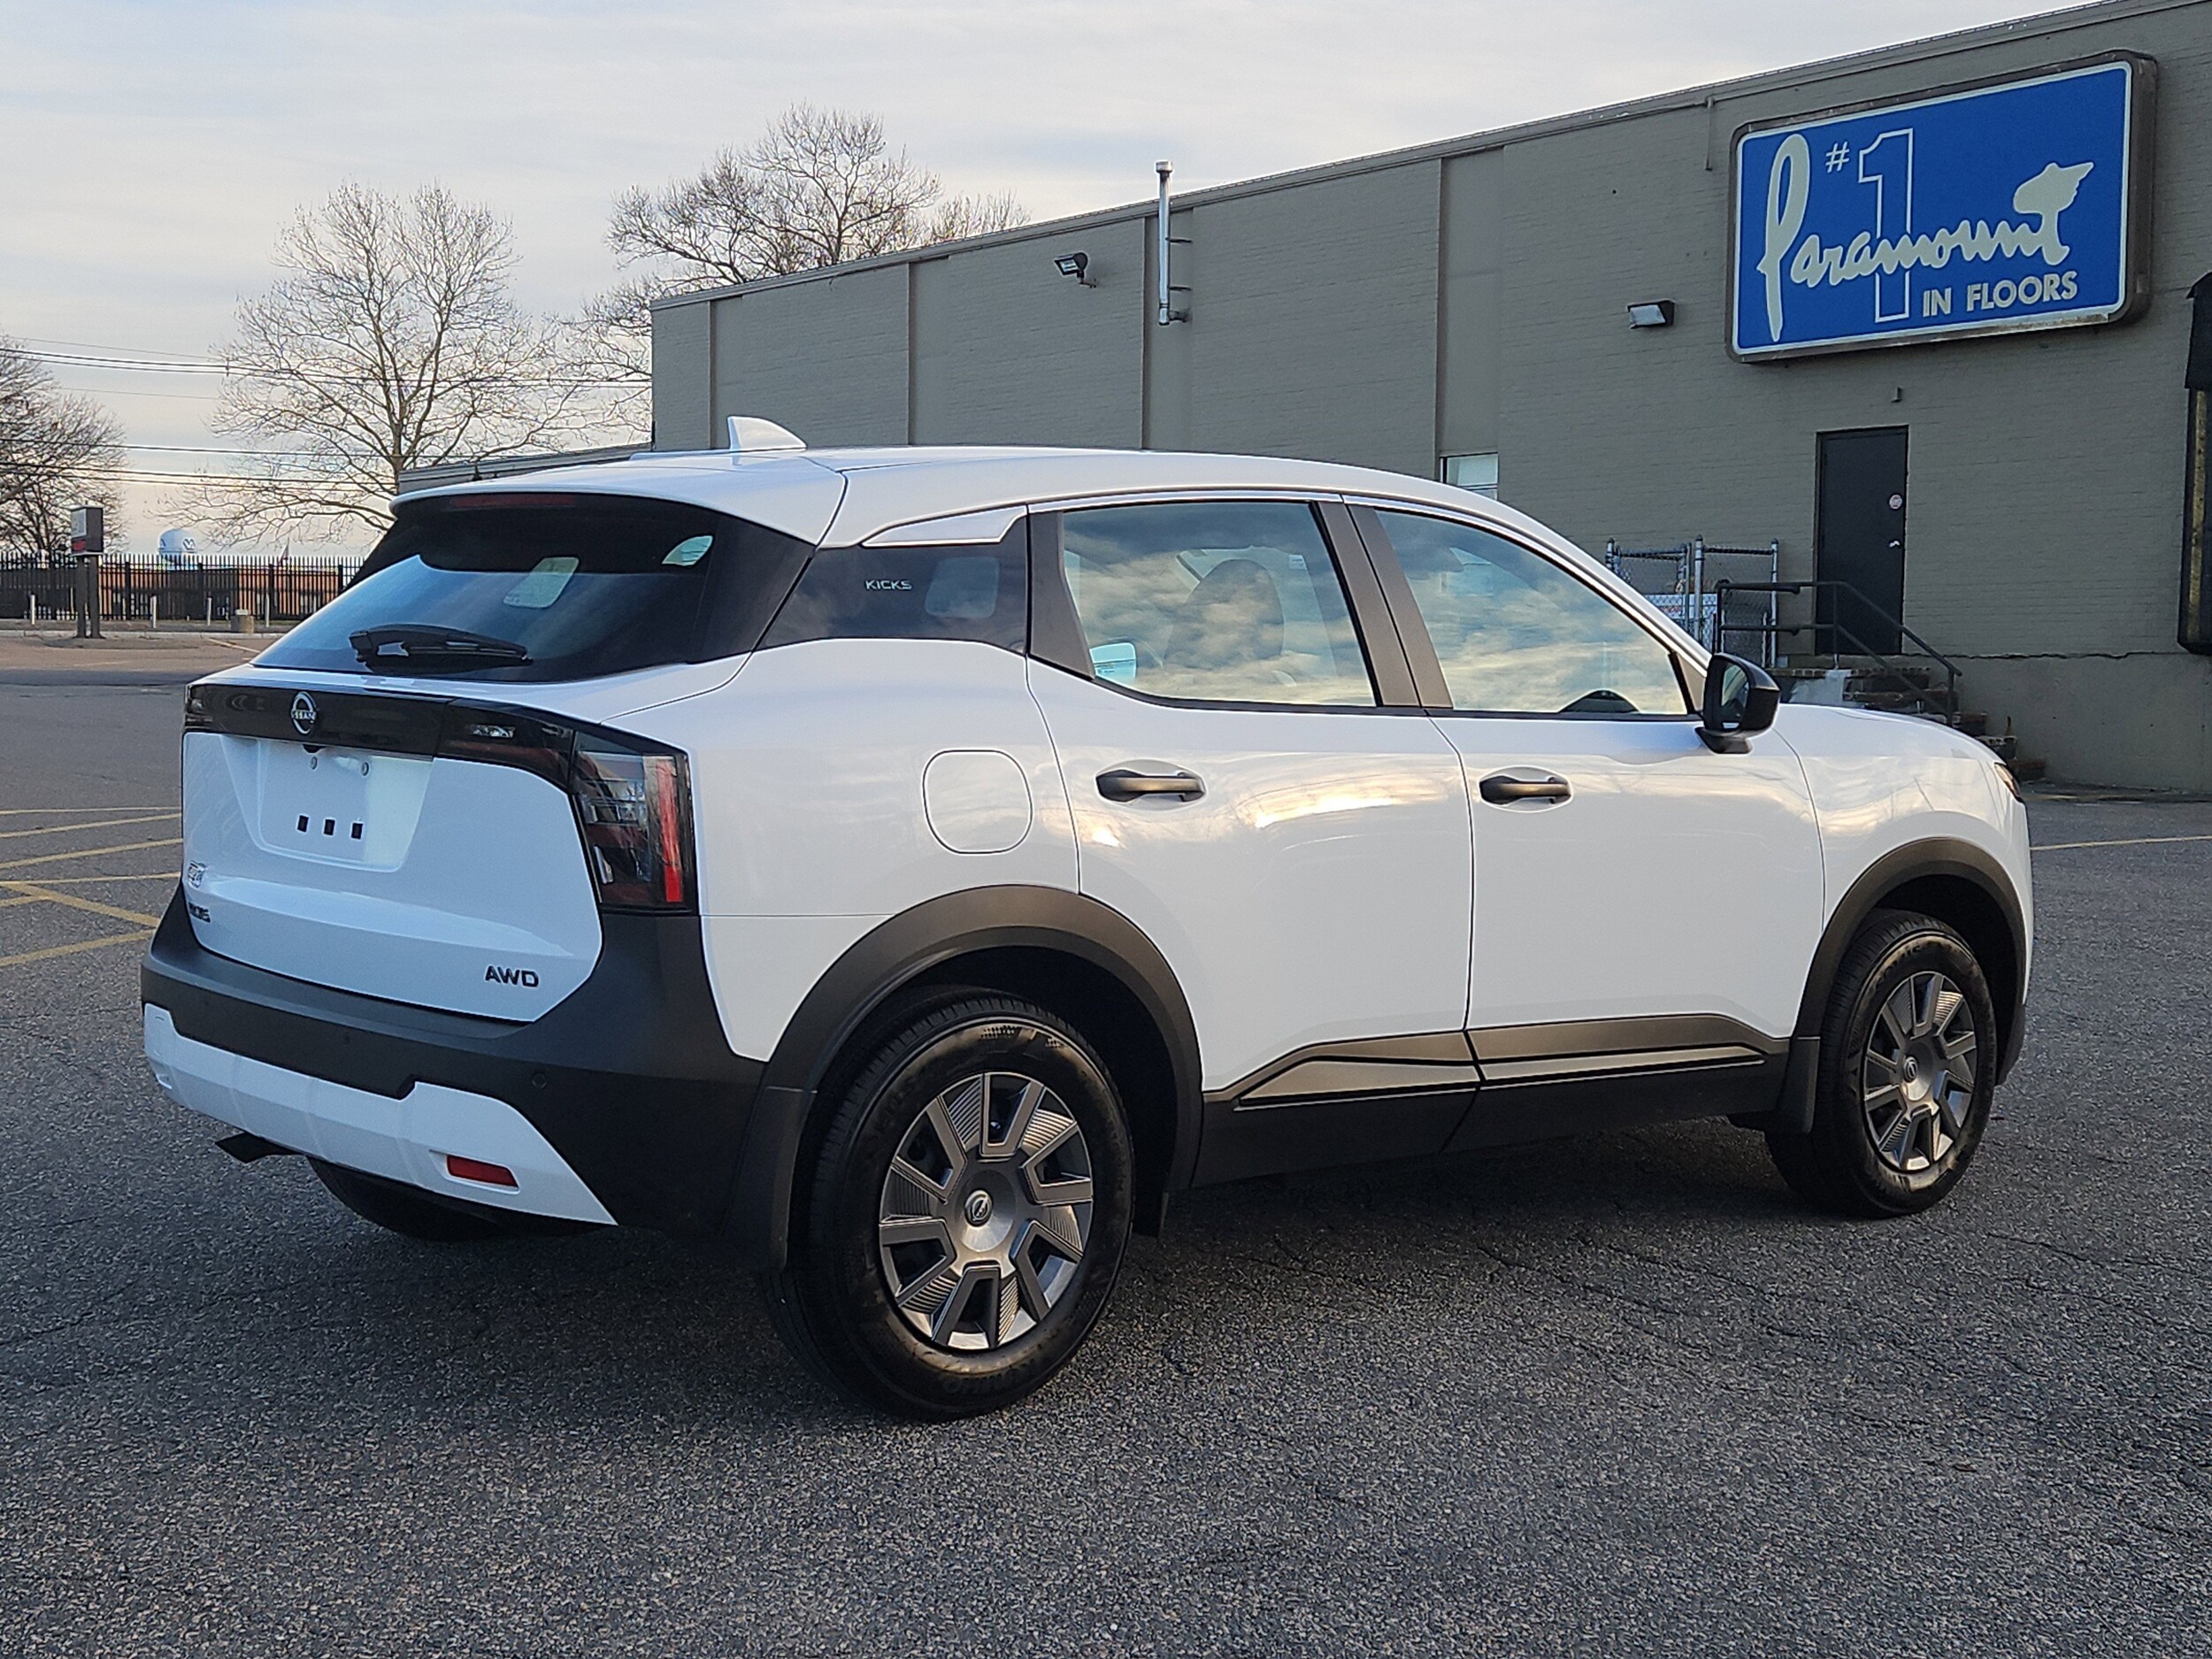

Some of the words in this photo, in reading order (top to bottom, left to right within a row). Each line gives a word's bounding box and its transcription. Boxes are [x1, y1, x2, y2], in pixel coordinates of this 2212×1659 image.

[1756, 134, 2094, 342] Paramount
[1922, 287, 1952, 318] IN
[1966, 271, 2078, 311] FLOORS
[864, 580, 913, 590] KICKS
[485, 965, 540, 987] AWD
